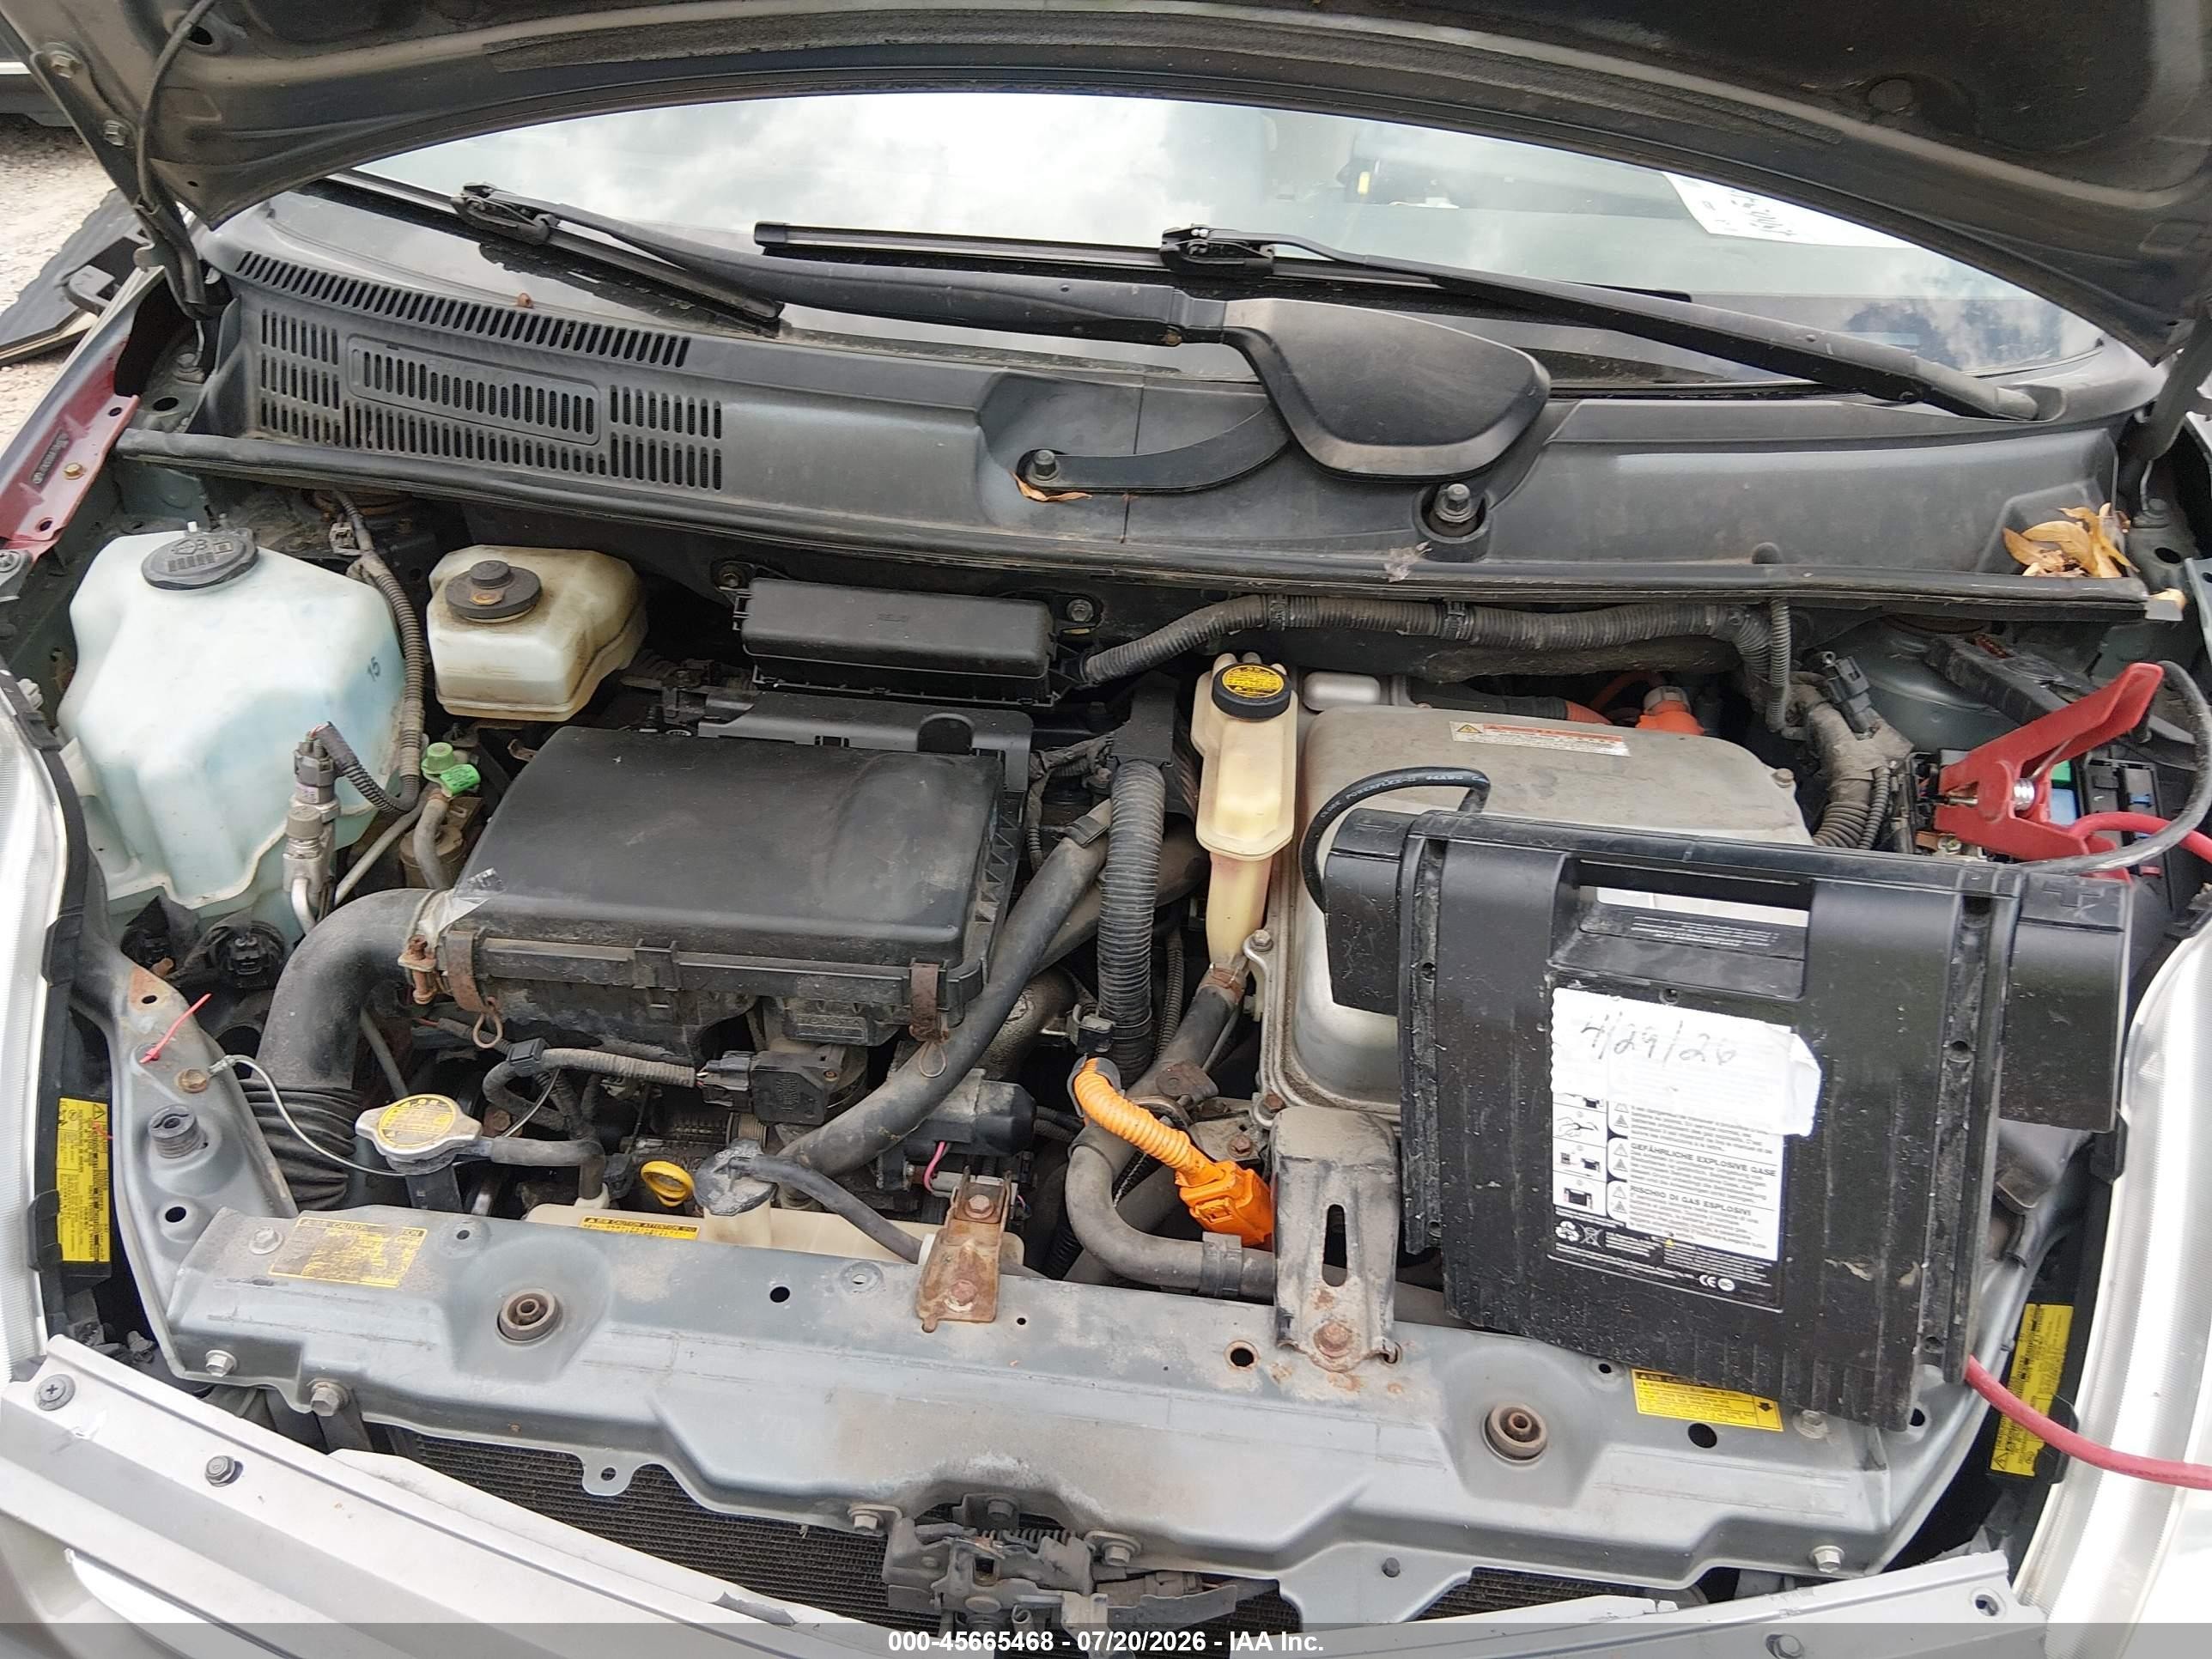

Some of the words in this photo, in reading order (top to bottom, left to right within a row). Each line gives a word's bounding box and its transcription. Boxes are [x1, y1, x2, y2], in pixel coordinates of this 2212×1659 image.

[1696, 1155, 1748, 1171] EXPLOSIVE
[1631, 1185, 1667, 1199] RISCHIO
[1668, 1193, 1680, 1201] DI
[1681, 1195, 1700, 1206] GAS
[1703, 1200, 1752, 1216] ESPLOSIVI
